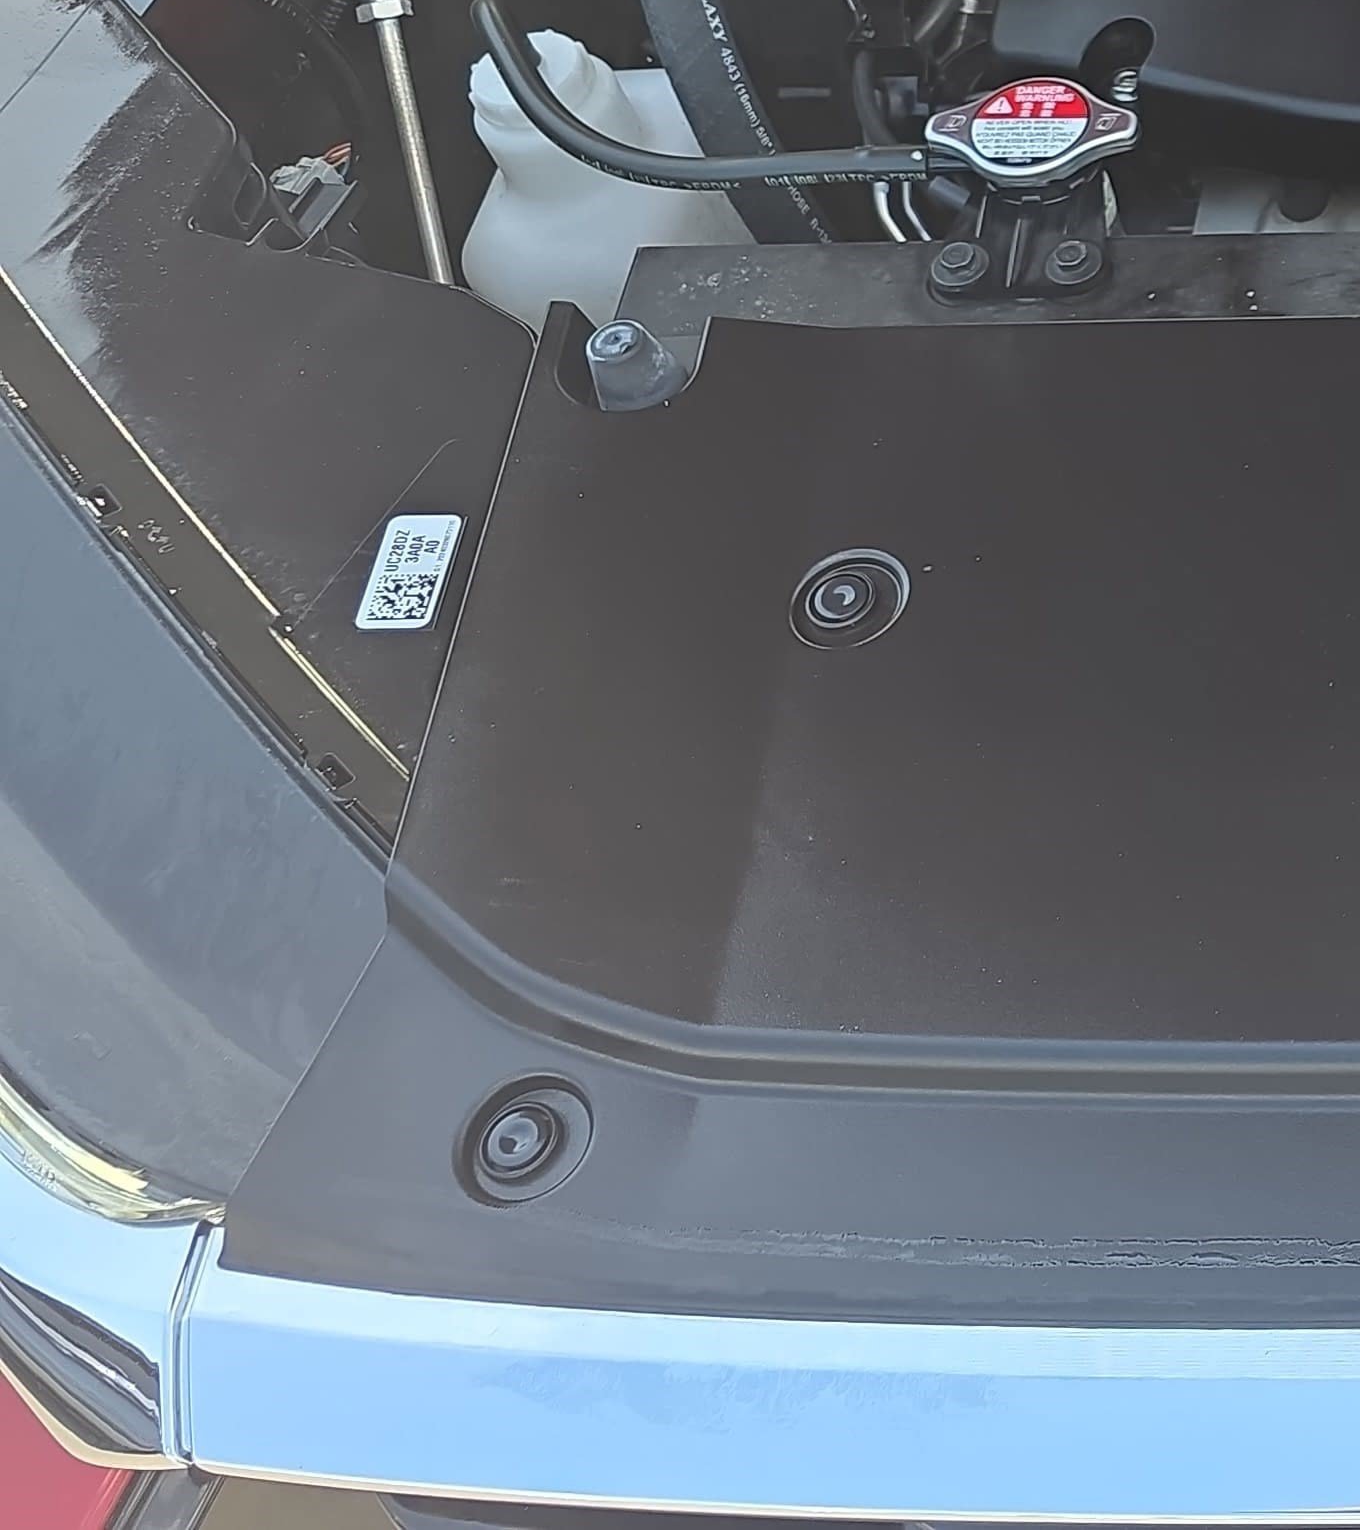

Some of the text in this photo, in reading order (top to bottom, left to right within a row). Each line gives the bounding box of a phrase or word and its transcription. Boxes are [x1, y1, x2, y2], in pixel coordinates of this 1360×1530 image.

[720, 45, 743, 83] 4843
[1014, 93, 1075, 103] WARNING
[1016, 85, 1066, 94] DANGER
[384, 530, 411, 572] UC28DZ
